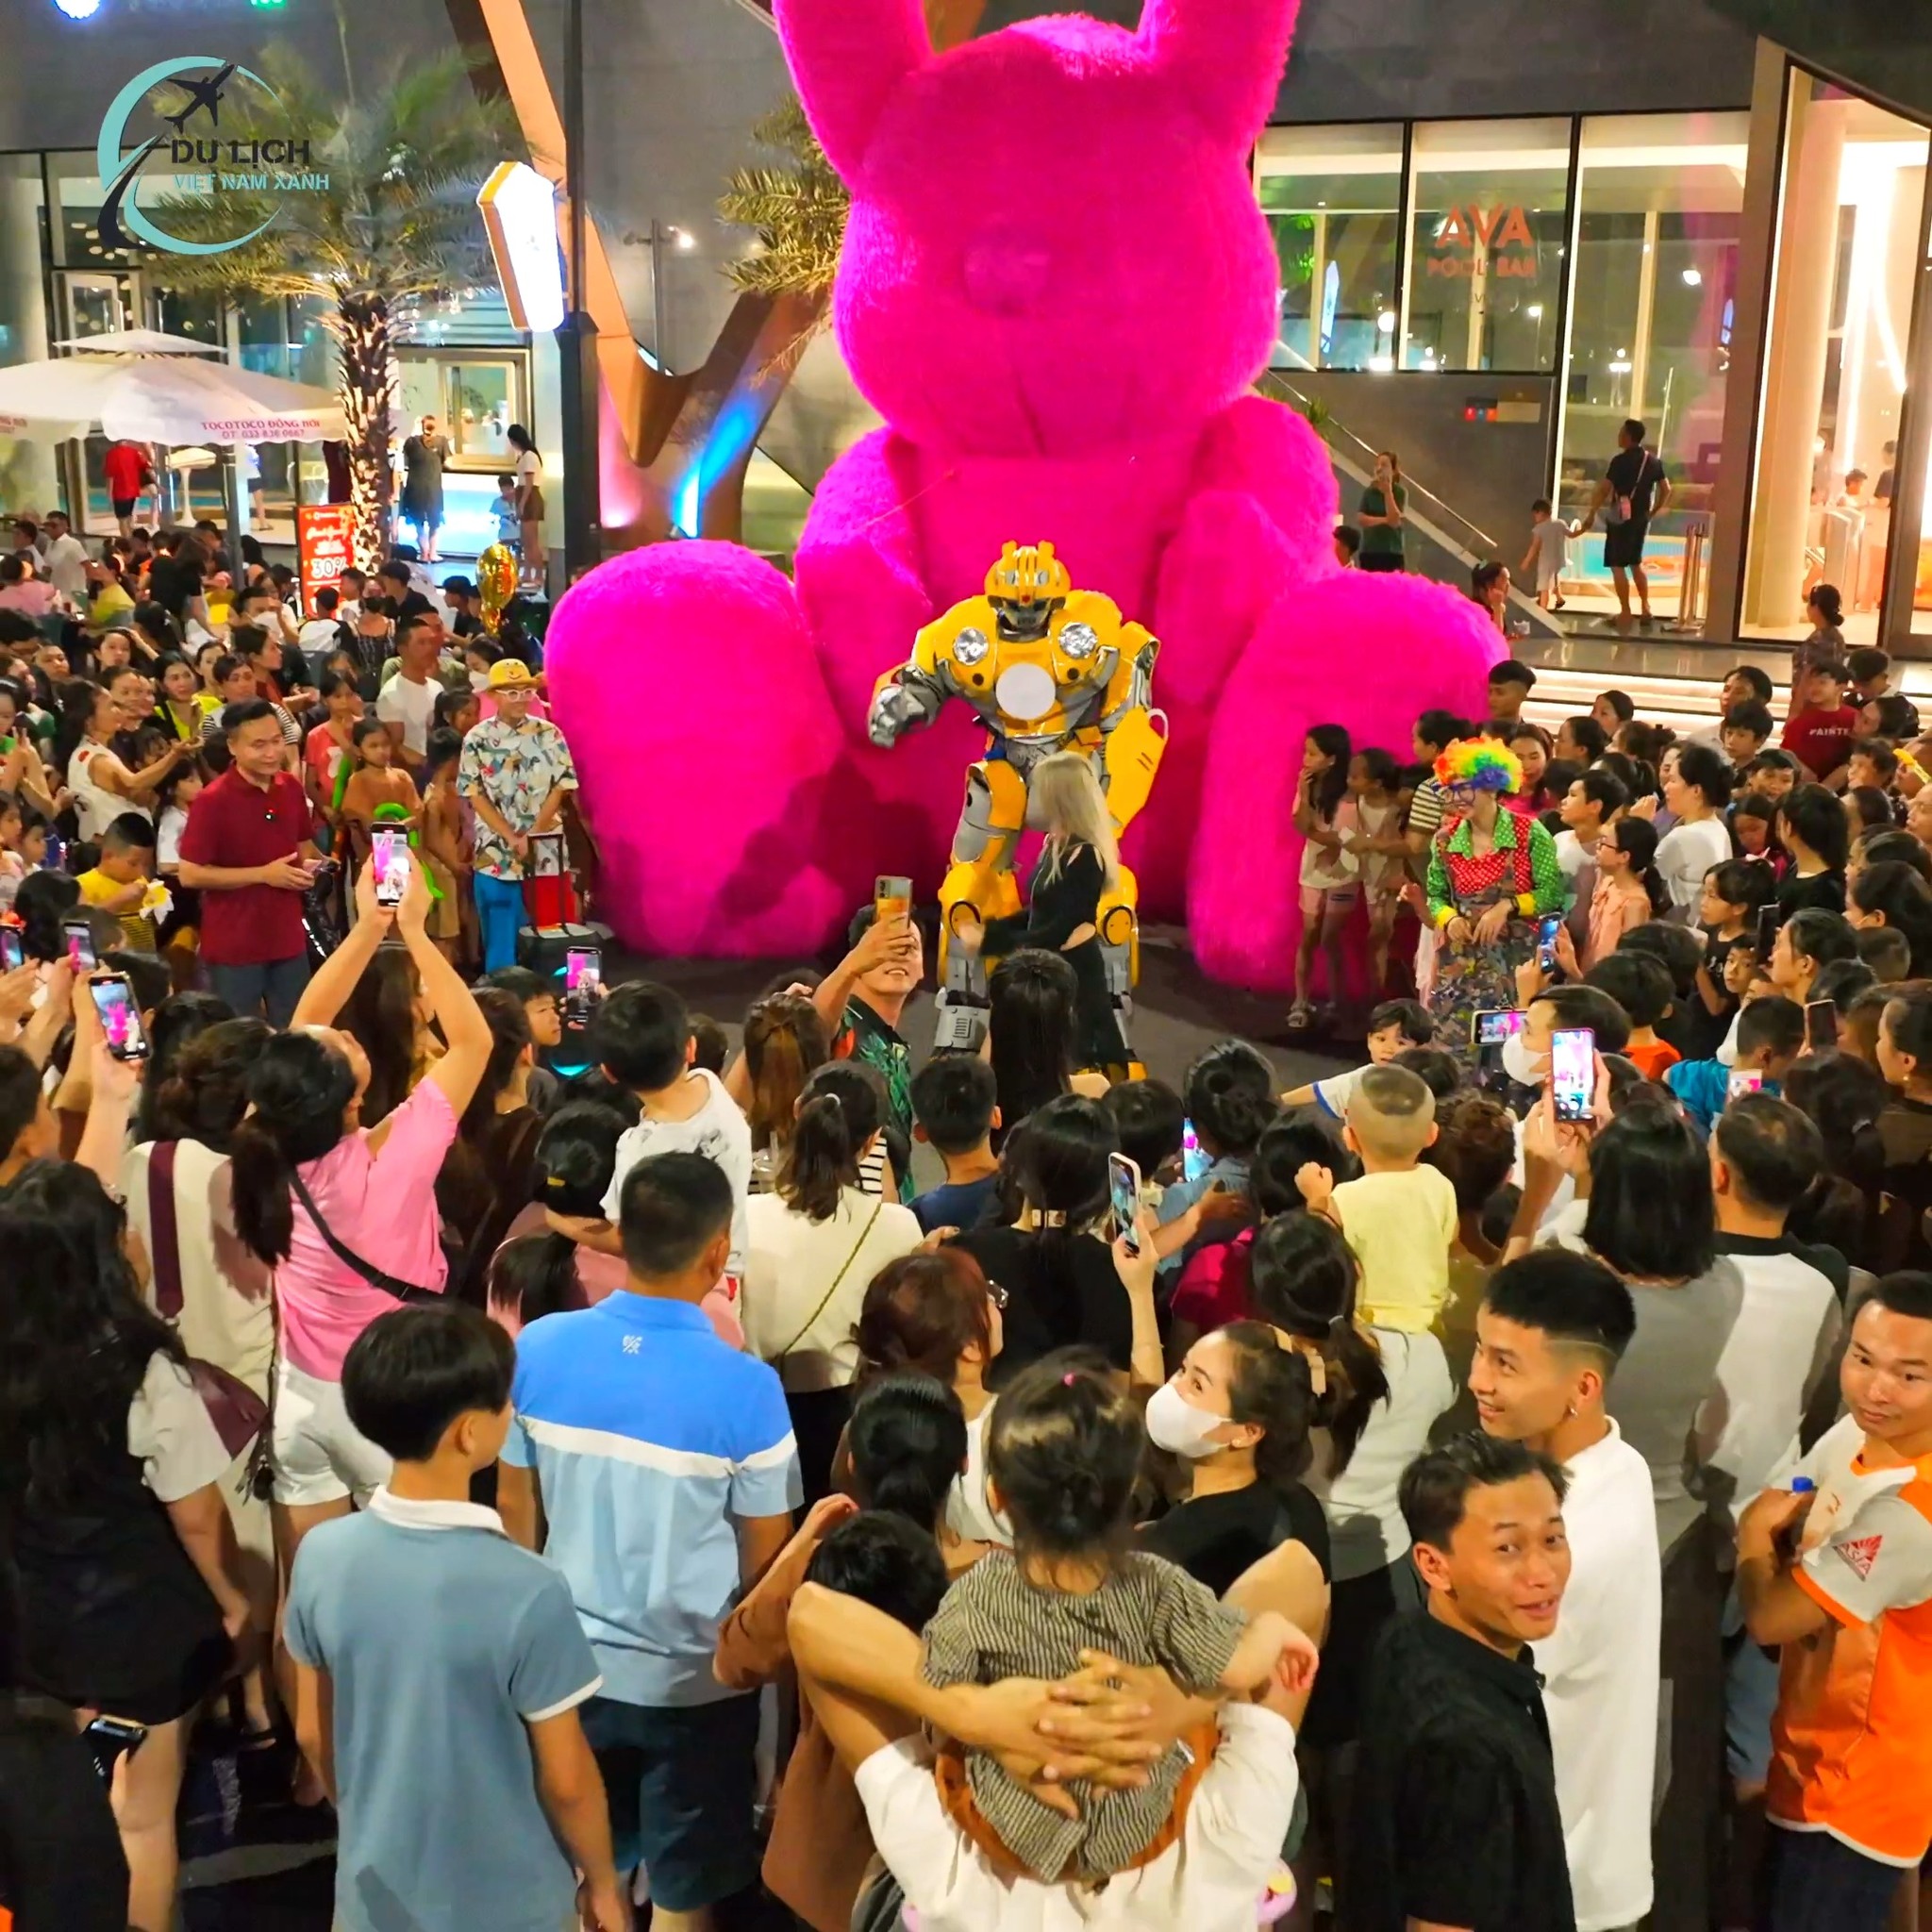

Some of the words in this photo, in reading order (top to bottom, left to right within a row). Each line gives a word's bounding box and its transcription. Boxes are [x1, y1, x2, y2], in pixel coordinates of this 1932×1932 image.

[1435, 203, 1535, 248] AVA
[1426, 256, 1485, 277] POOL
[1496, 256, 1537, 278] BAR
[200, 420, 265, 430] TOCOTOCO
[310, 557, 348, 578] 30%
